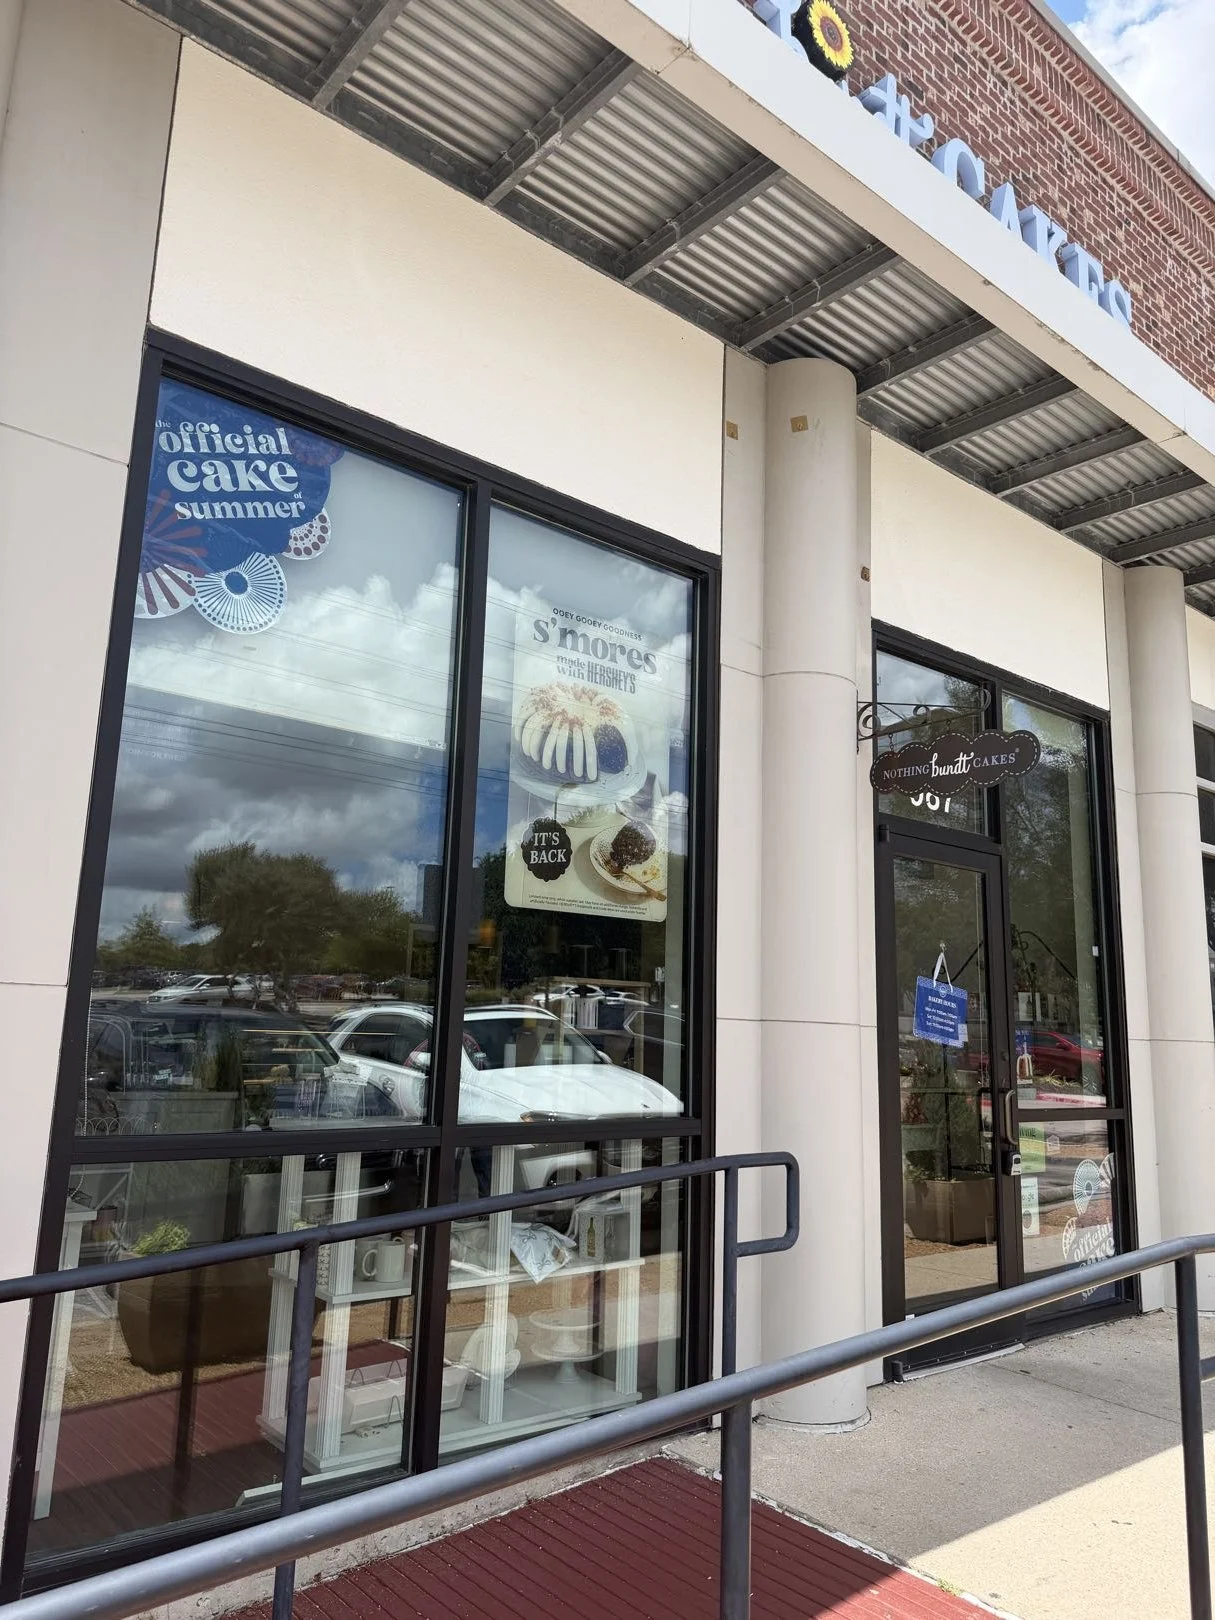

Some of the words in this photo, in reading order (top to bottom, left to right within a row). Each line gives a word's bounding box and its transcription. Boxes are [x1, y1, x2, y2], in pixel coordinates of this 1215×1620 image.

[158, 421, 293, 456] official
[166, 459, 299, 493] cake
[293, 491, 303, 499] of
[174, 500, 306, 520] summer
[552, 607, 575, 620] OOEY
[575, 615, 603, 629] GOOEY
[603, 624, 643, 642] GOODNESS
[533, 616, 657, 675] s'mores
[556, 655, 586, 669] made
[557, 665, 585, 681] with
[587, 661, 637, 695] HERSHEY'S
[882, 764, 930, 780] NOTHING
[930, 751, 974, 778] bundt
[973, 752, 1017, 768] CAKES
[533, 831, 560, 847] IT'S
[530, 848, 567, 865] BACK
